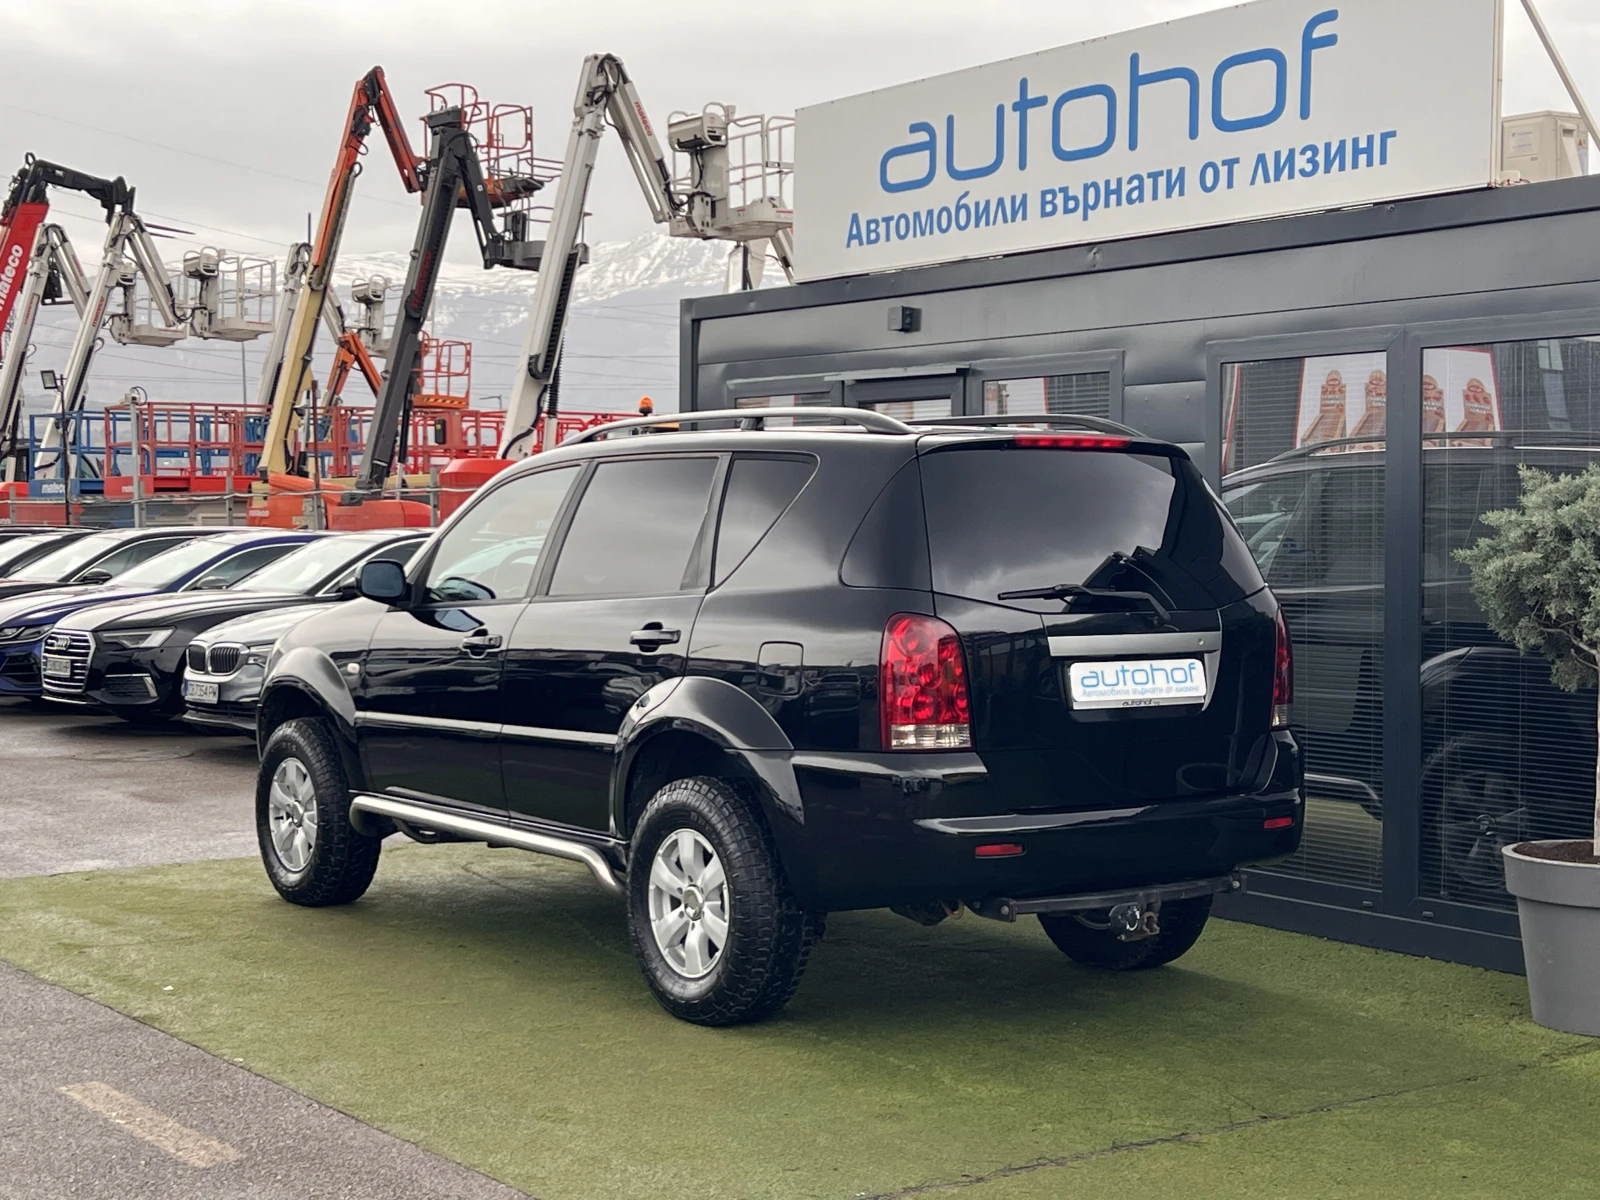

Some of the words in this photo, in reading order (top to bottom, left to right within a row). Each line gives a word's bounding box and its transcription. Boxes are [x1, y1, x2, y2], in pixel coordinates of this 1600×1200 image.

[634, 101, 653, 137] mateco
[879, 9, 1338, 193] autohof
[847, 193, 1028, 247] Автомобили
[1039, 167, 1186, 222] върнати
[1199, 157, 1240, 194] от
[1250, 130, 1398, 186] лизинг
[1080, 661, 1197, 688] autohof
